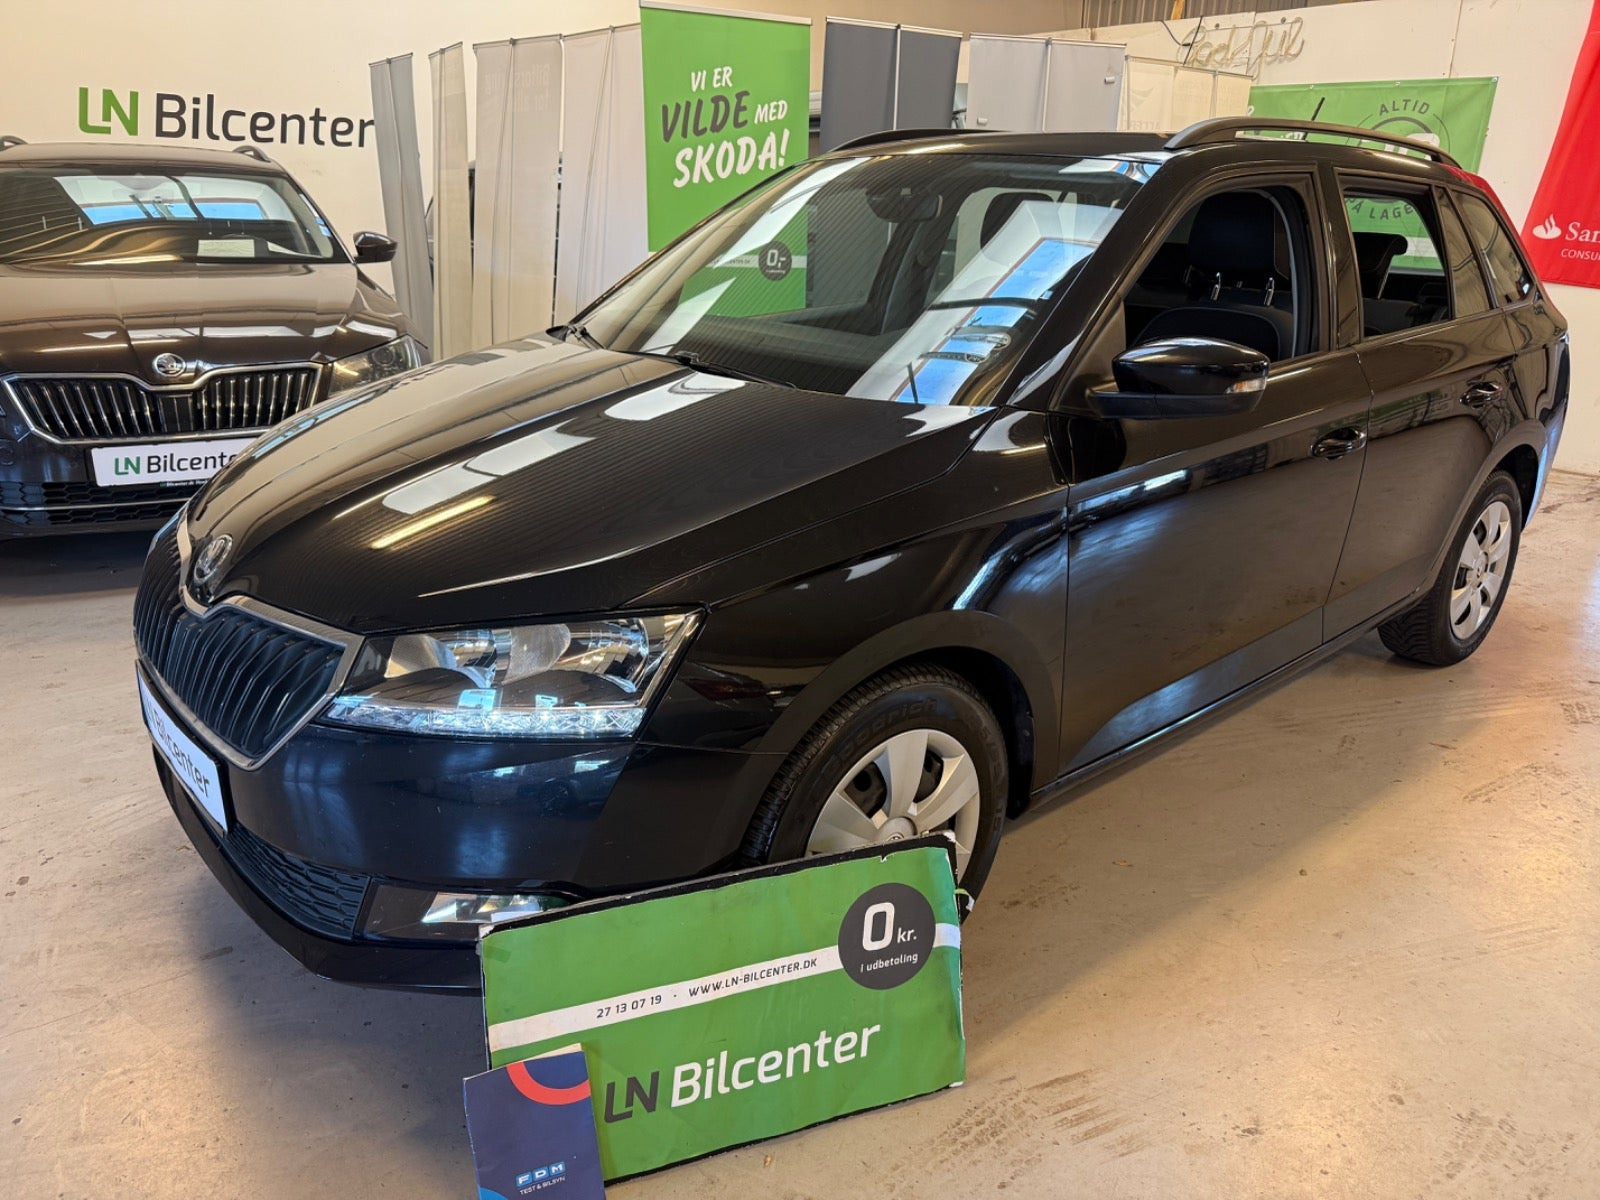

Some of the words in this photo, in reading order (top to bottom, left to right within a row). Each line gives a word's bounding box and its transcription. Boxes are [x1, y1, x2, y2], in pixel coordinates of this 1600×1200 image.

[690, 69, 707, 93] VI
[712, 65, 734, 89] ER
[78, 86, 140, 137] LN
[154, 92, 376, 149] Bilcenter
[661, 90, 751, 144] VILDE
[753, 99, 789, 125] MED
[1379, 99, 1431, 117] ALTID
[672, 127, 790, 189] SKODA!
[1369, 203, 1413, 220] LAGE
[1561, 248, 1600, 261] CONSU
[114, 456, 141, 476] LN
[146, 451, 238, 474] Bilcent
[862, 901, 895, 952] 0
[897, 927, 918, 943] kr.
[866, 953, 919, 972] udbetaling
[596, 1006, 612, 1019] 27
[615, 1003, 628, 1014] 13
[631, 999, 646, 1011] 07
[650, 994, 662, 1005] 19
[688, 957, 818, 998] WWW.LN-BILCENTER.DK
[604, 1070, 660, 1124] LN
[670, 1024, 881, 1108] Bilcenter
[518, 1163, 564, 1185] FDM
[520, 1186, 536, 1196] TEST
